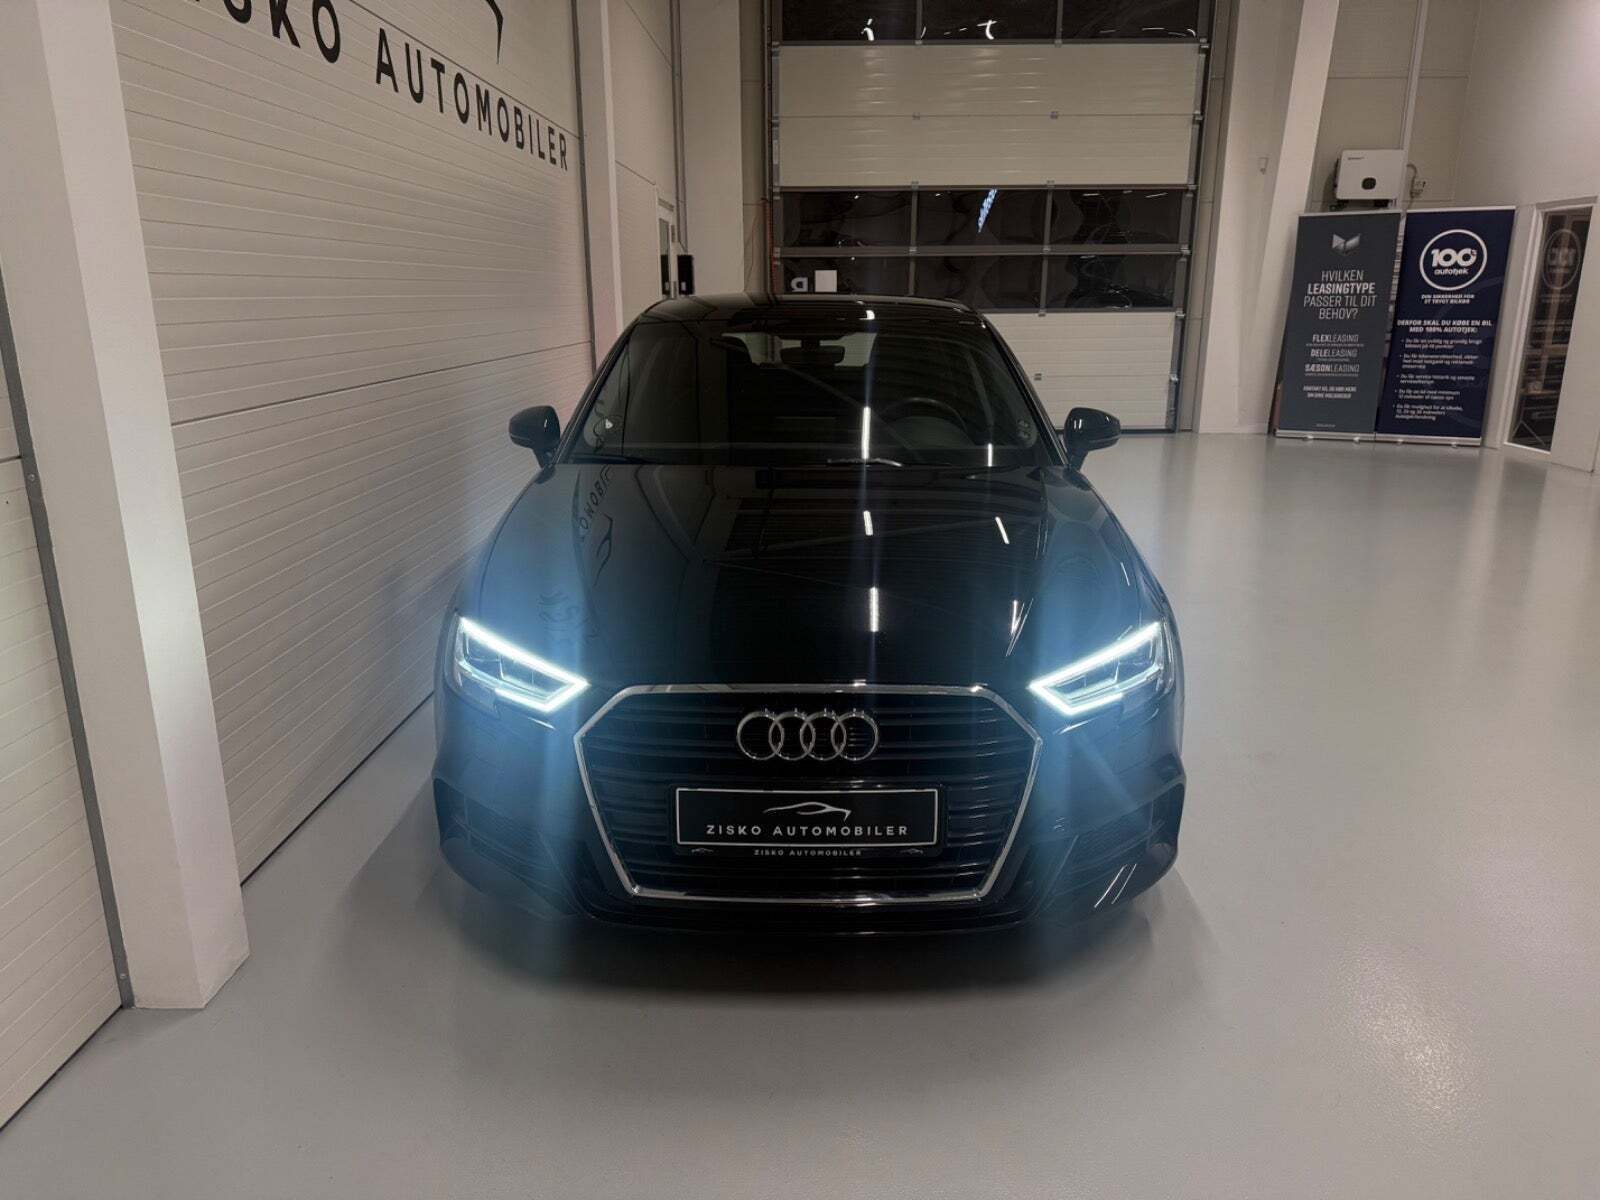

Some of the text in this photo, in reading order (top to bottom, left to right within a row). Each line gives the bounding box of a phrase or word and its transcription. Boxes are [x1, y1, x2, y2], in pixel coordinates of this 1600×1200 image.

[375, 28, 568, 171] AUTOMOBILER
[1321, 270, 1364, 281] HVILKEN
[1307, 282, 1376, 295] LEASINGTYPE
[1303, 295, 1377, 307] PASSER TIL DIT
[1319, 307, 1358, 320] BEHOV?
[1312, 334, 1359, 343] FLEXLEASING
[1310, 348, 1358, 358] DELELEASING
[706, 825, 909, 837] ZISKO AUTOMOBILER
[789, 849, 862, 857] AUTOMOBILER
